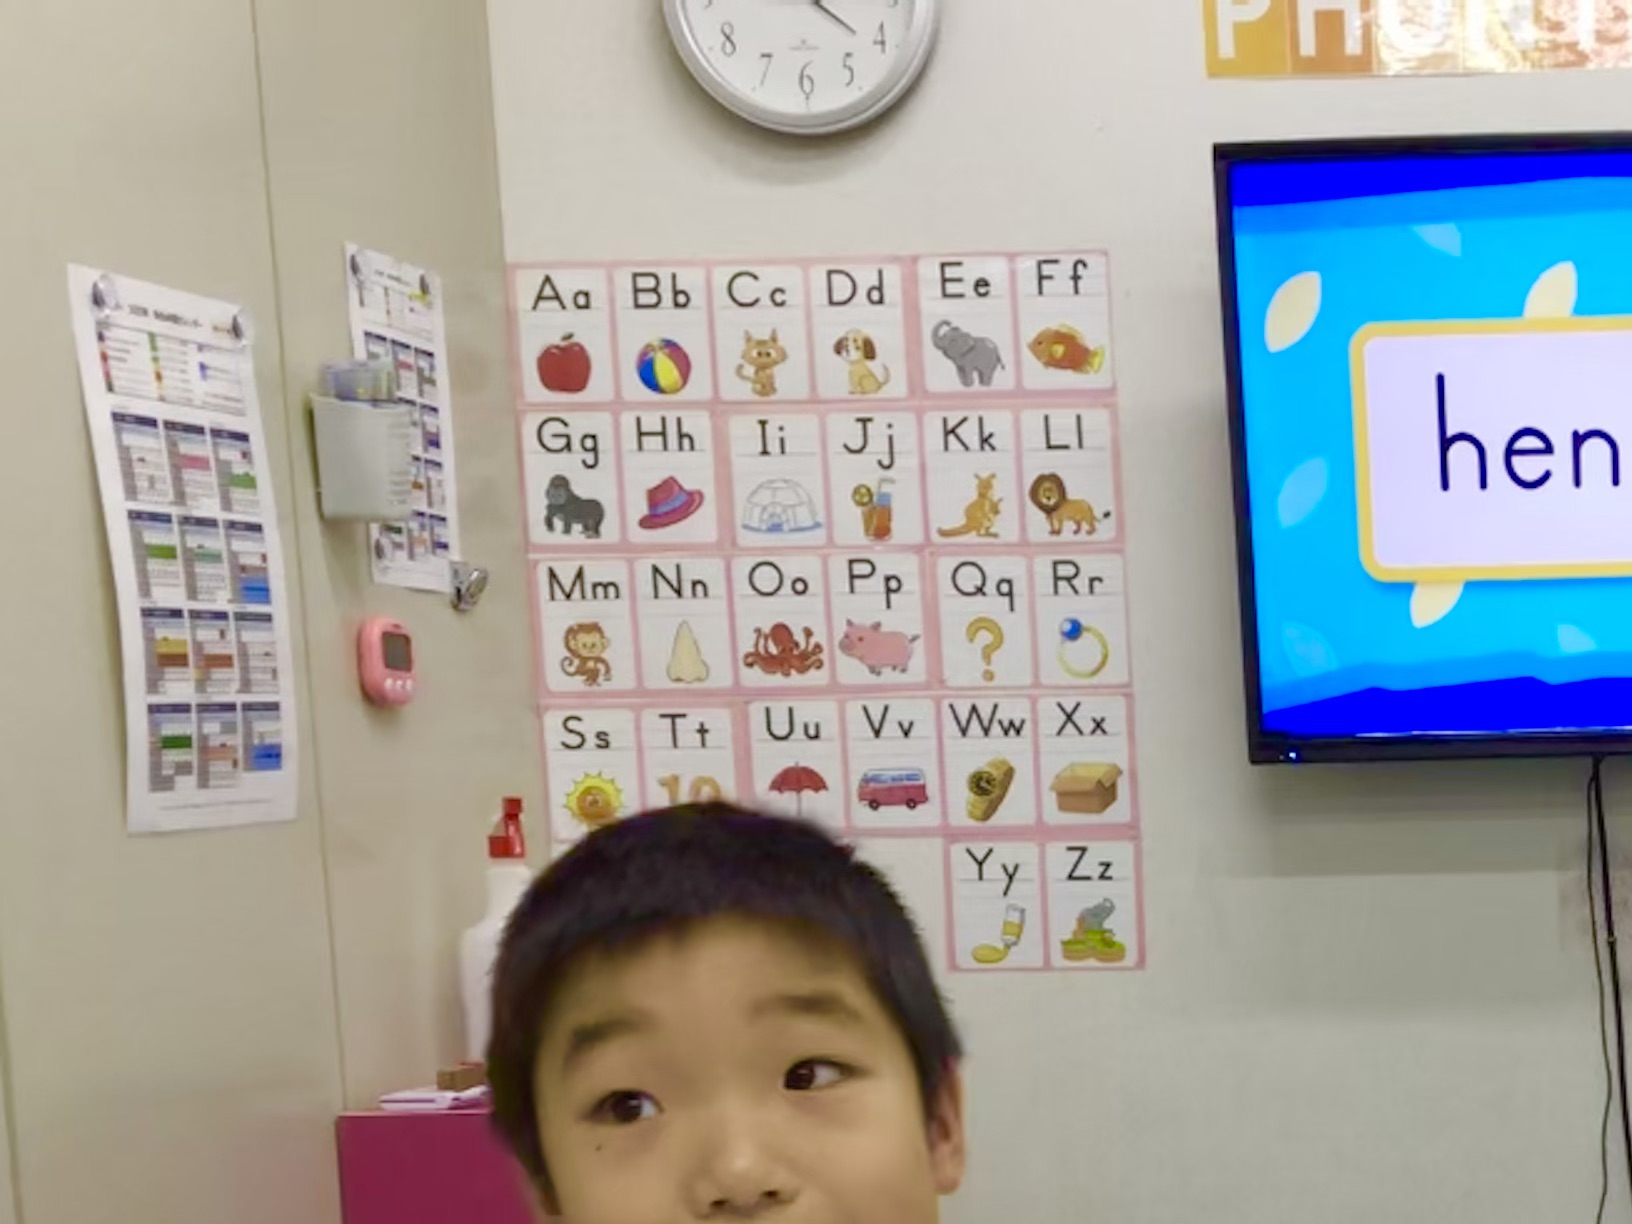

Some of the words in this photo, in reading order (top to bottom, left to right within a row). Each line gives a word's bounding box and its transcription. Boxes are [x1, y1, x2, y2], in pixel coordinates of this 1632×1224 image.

[720, 22, 737, 57] 8
[872, 20, 888, 54] 4
[759, 52, 774, 87] 7
[799, 60, 815, 95] 6
[842, 52, 855, 87] 5
[532, 275, 590, 310] Aa
[632, 272, 691, 309] Bb
[727, 271, 786, 308] Cc
[827, 269, 884, 306] Dd
[940, 262, 990, 298] Ee
[1037, 259, 1088, 295] Ff
[537, 417, 599, 470] Gg
[636, 416, 695, 452] Hh
[843, 417, 894, 470] Jj
[943, 416, 996, 451] Kk
[1435, 372, 1620, 491] hen
[548, 566, 620, 601] Mm
[651, 563, 708, 599] Nn
[748, 561, 809, 597] Oo
[848, 558, 902, 609] Pp
[951, 561, 1014, 612] Qq
[1052, 560, 1103, 595] Rr
[561, 715, 610, 750] Ss
[659, 713, 709, 749] Tt
[765, 706, 821, 741] Uu
[863, 704, 914, 739] Vv
[949, 703, 1025, 738] Ww
[1056, 702, 1107, 736] Xx
[965, 848, 1019, 897] Yy
[1066, 846, 1113, 881] Zz
